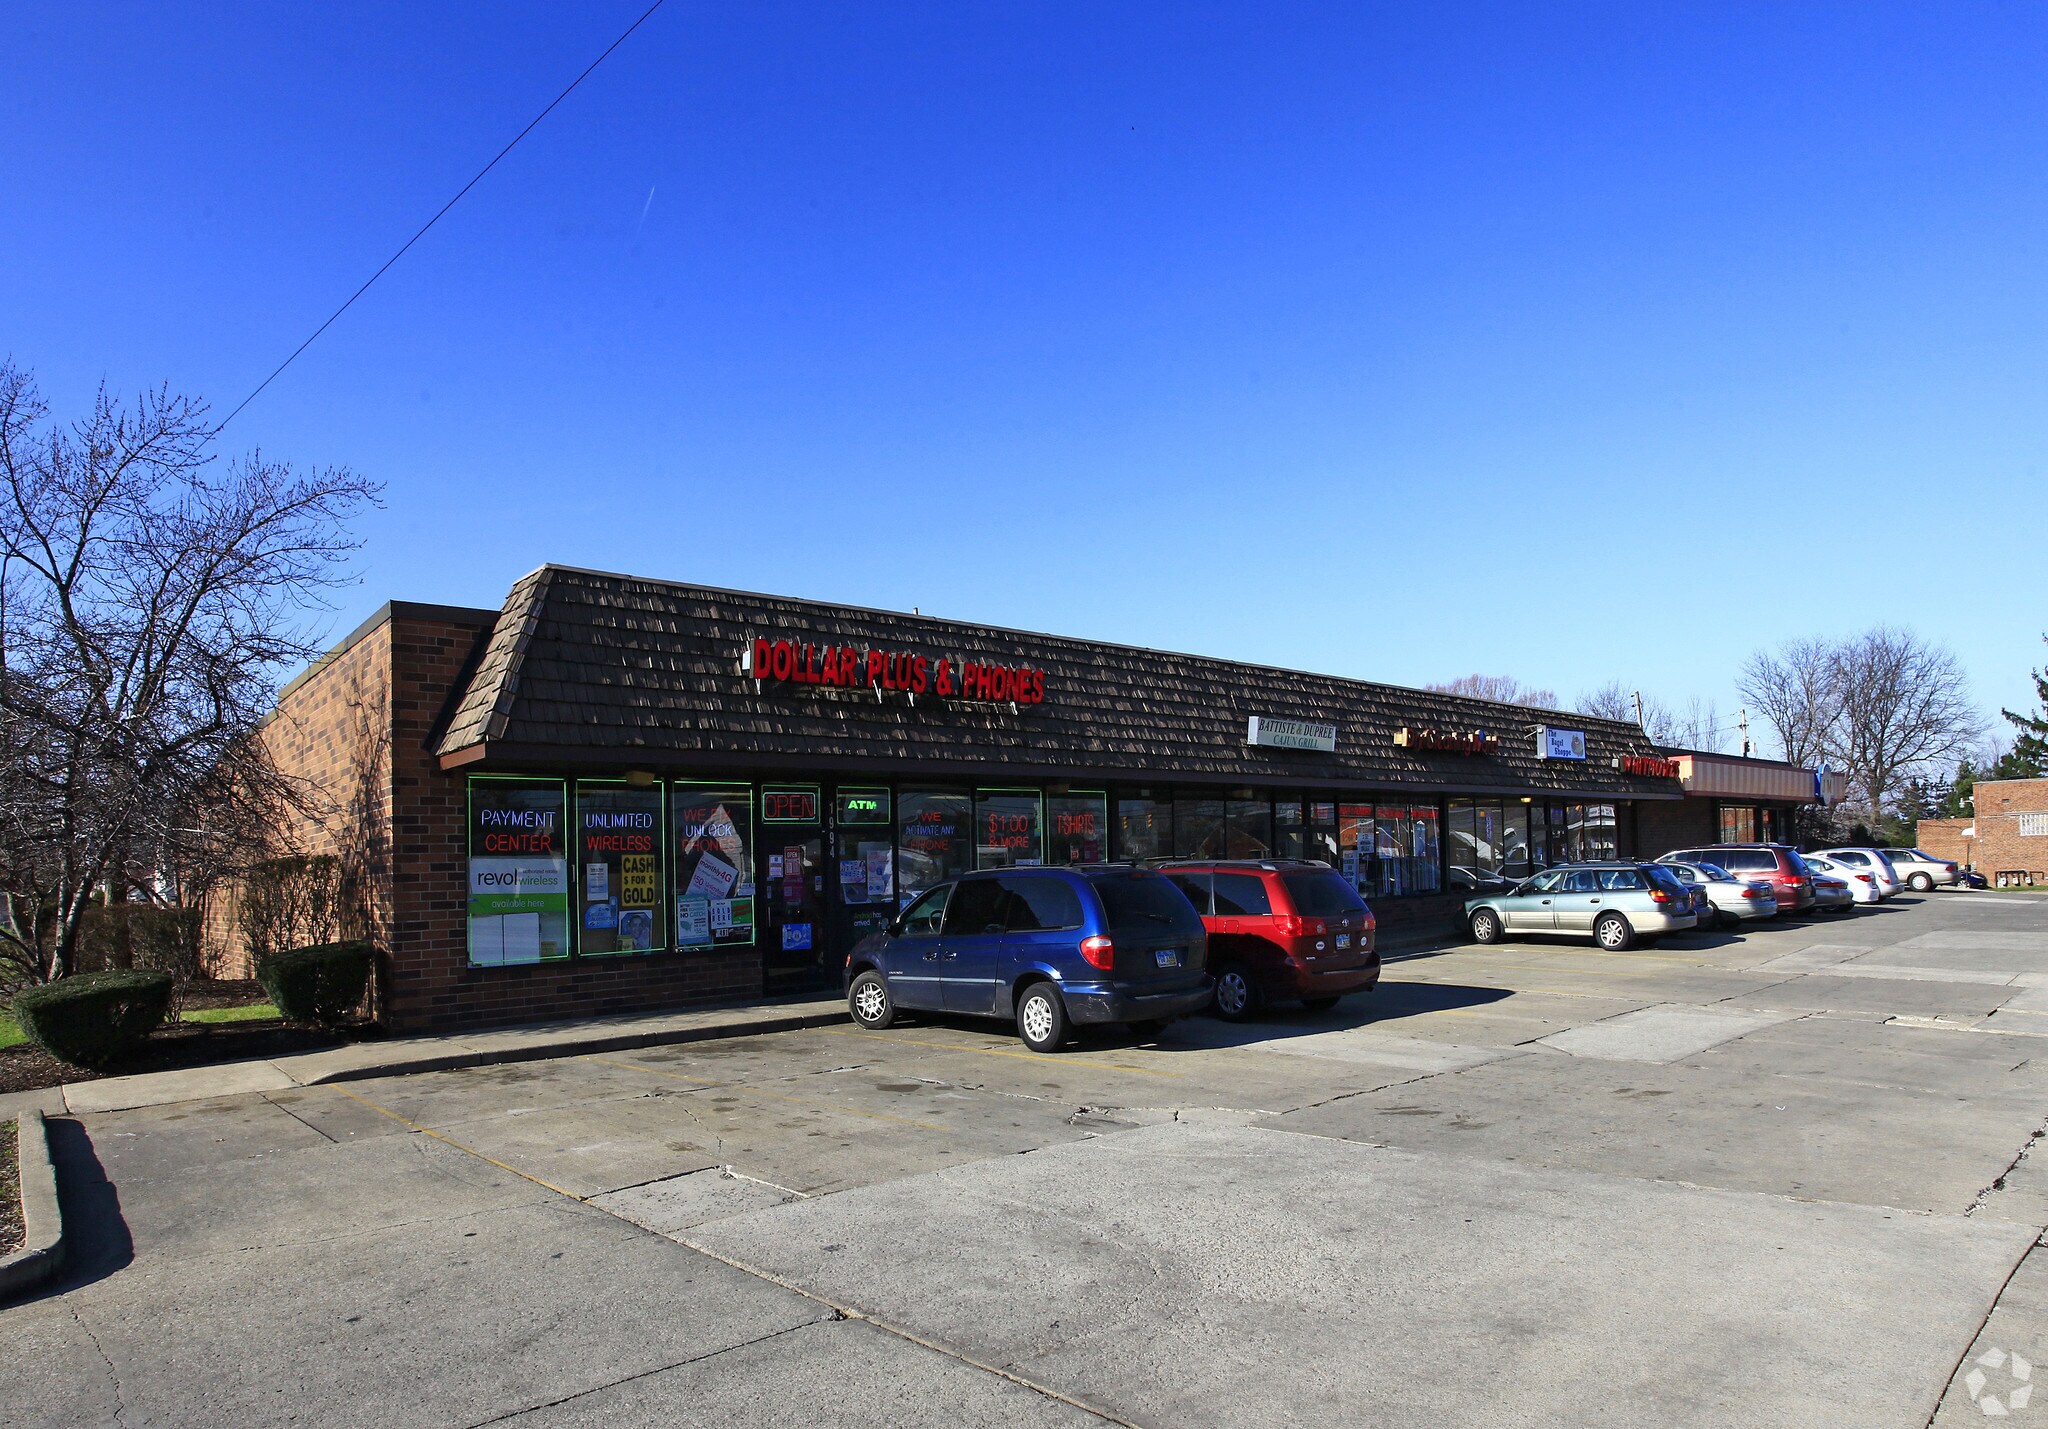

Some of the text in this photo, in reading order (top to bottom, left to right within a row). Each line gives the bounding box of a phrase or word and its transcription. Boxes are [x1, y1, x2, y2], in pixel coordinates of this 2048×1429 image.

[753, 638, 1046, 704] DOLLAR PLUS & PHONES
[1258, 719, 1334, 739] BATTISTE & DUPREE
[1548, 729, 1556, 737] The
[1273, 734, 1319, 749] CAJUN GRILL
[1551, 738, 1564, 747] Bagel
[1554, 748, 1572, 756] Shoppe
[765, 794, 815, 819] OPEN
[847, 800, 877, 810] ATM
[481, 809, 556, 828] PAYMENT
[585, 812, 653, 829] UNLIMITED
[683, 808, 707, 823] WE
[920, 811, 942, 823] WE
[685, 823, 732, 838] UNLOCK
[905, 824, 955, 836] ACTIVATE ANY
[485, 833, 551, 852] CENTER
[586, 835, 652, 852] WIRELESS
[682, 838, 737, 853] PHONES
[910, 839, 950, 852] PHONE
[988, 834, 1030, 850] & MORE
[622, 857, 654, 874] CASH
[477, 867, 518, 886] revol
[518, 875, 559, 887] wireless
[623, 875, 654, 885] $ FOR $
[623, 887, 654, 904] GOLD
[491, 899, 545, 909] available here
